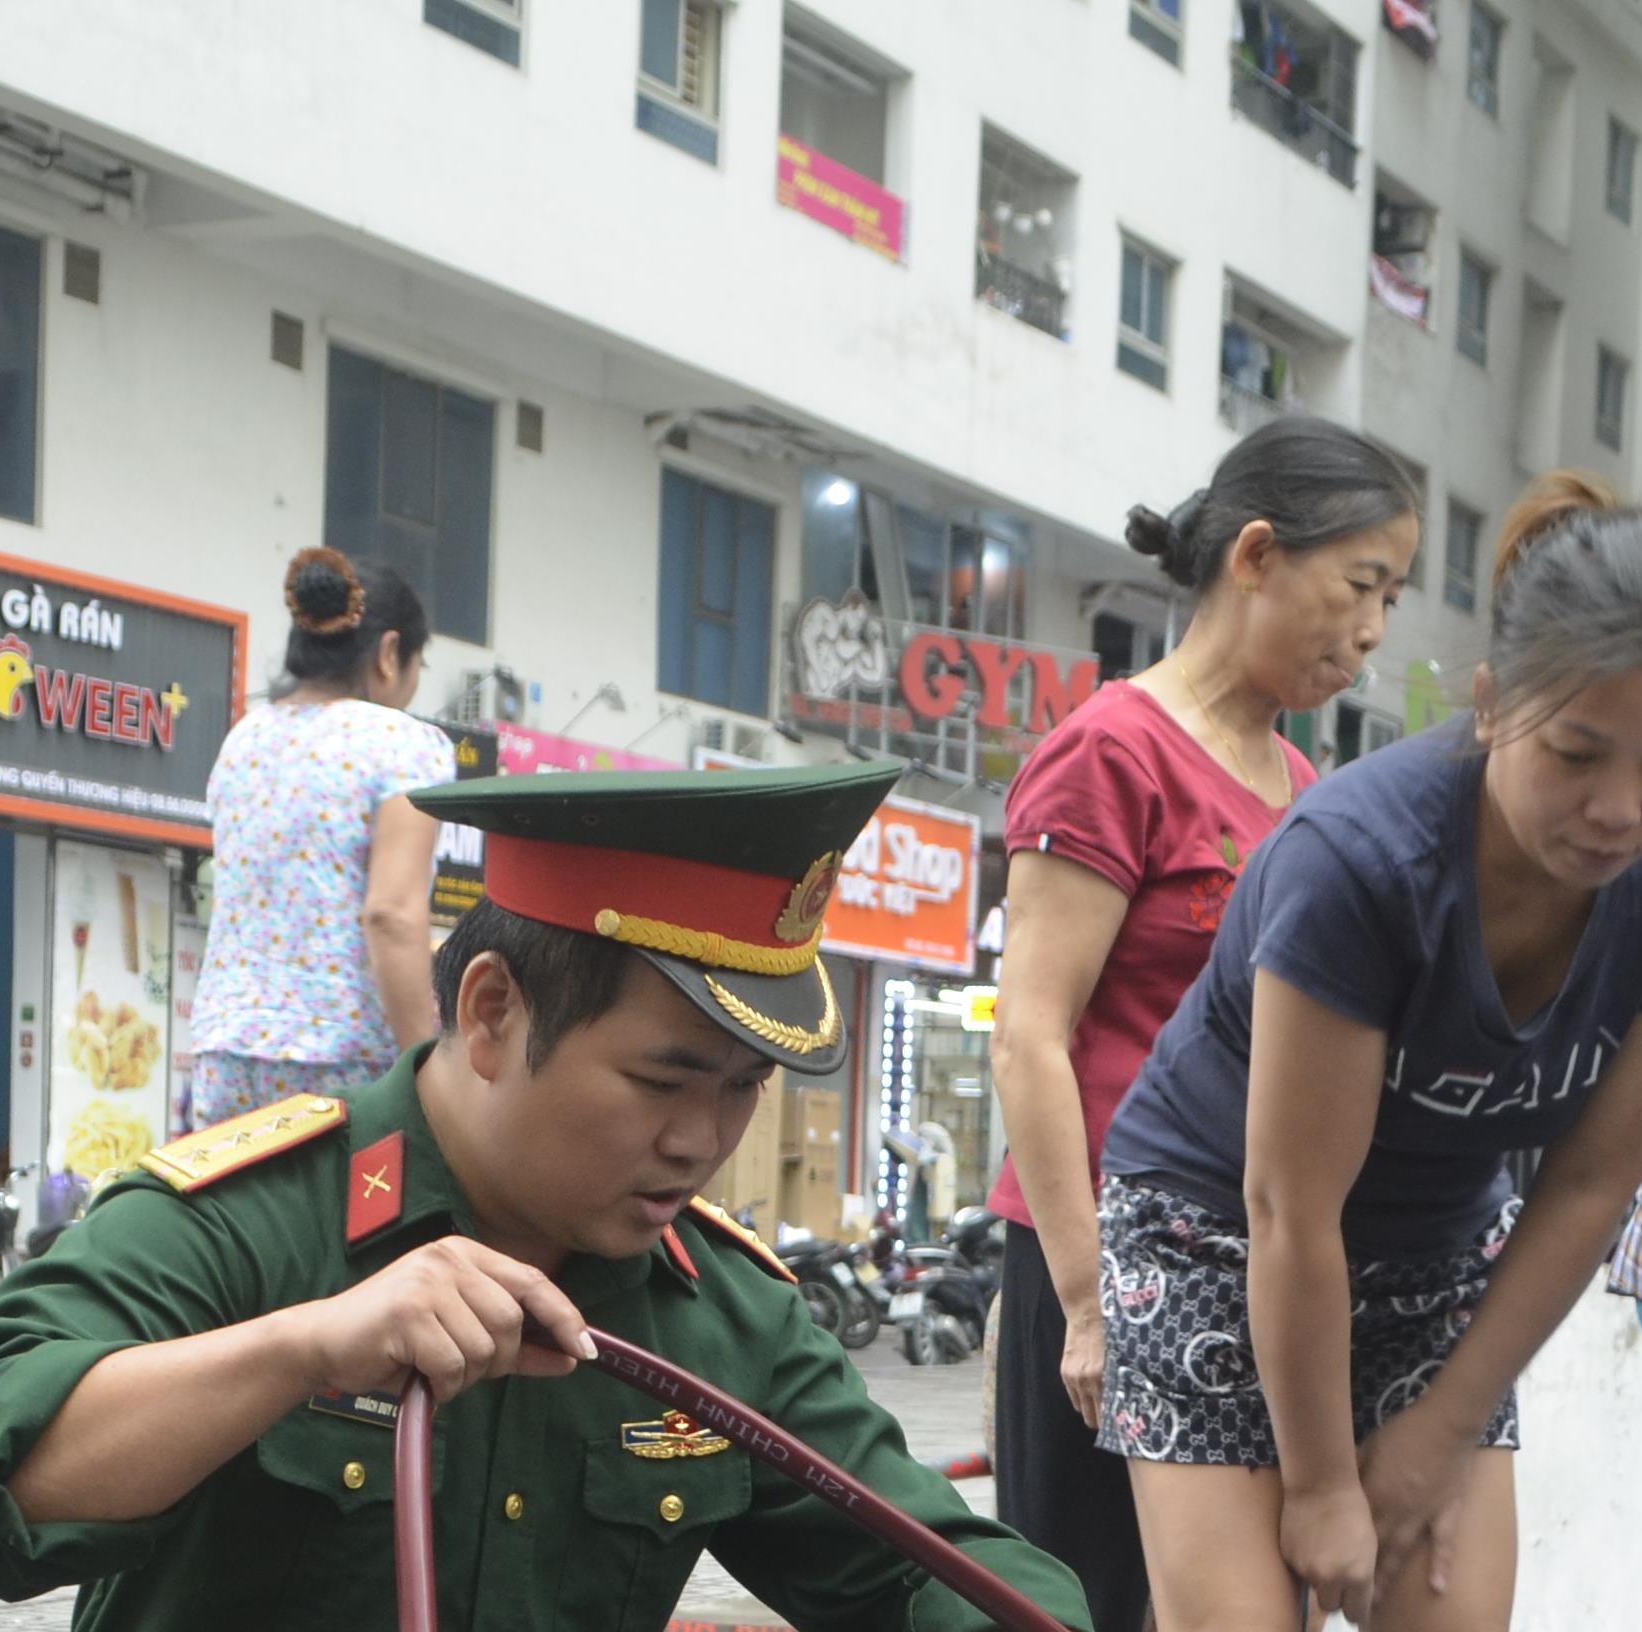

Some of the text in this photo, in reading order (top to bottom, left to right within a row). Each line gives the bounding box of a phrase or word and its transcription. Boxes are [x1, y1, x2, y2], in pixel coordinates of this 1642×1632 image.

[2, 584, 53, 634] GÀ
[60, 599, 124, 651] RÁN
[900, 632, 1100, 735] GYM
